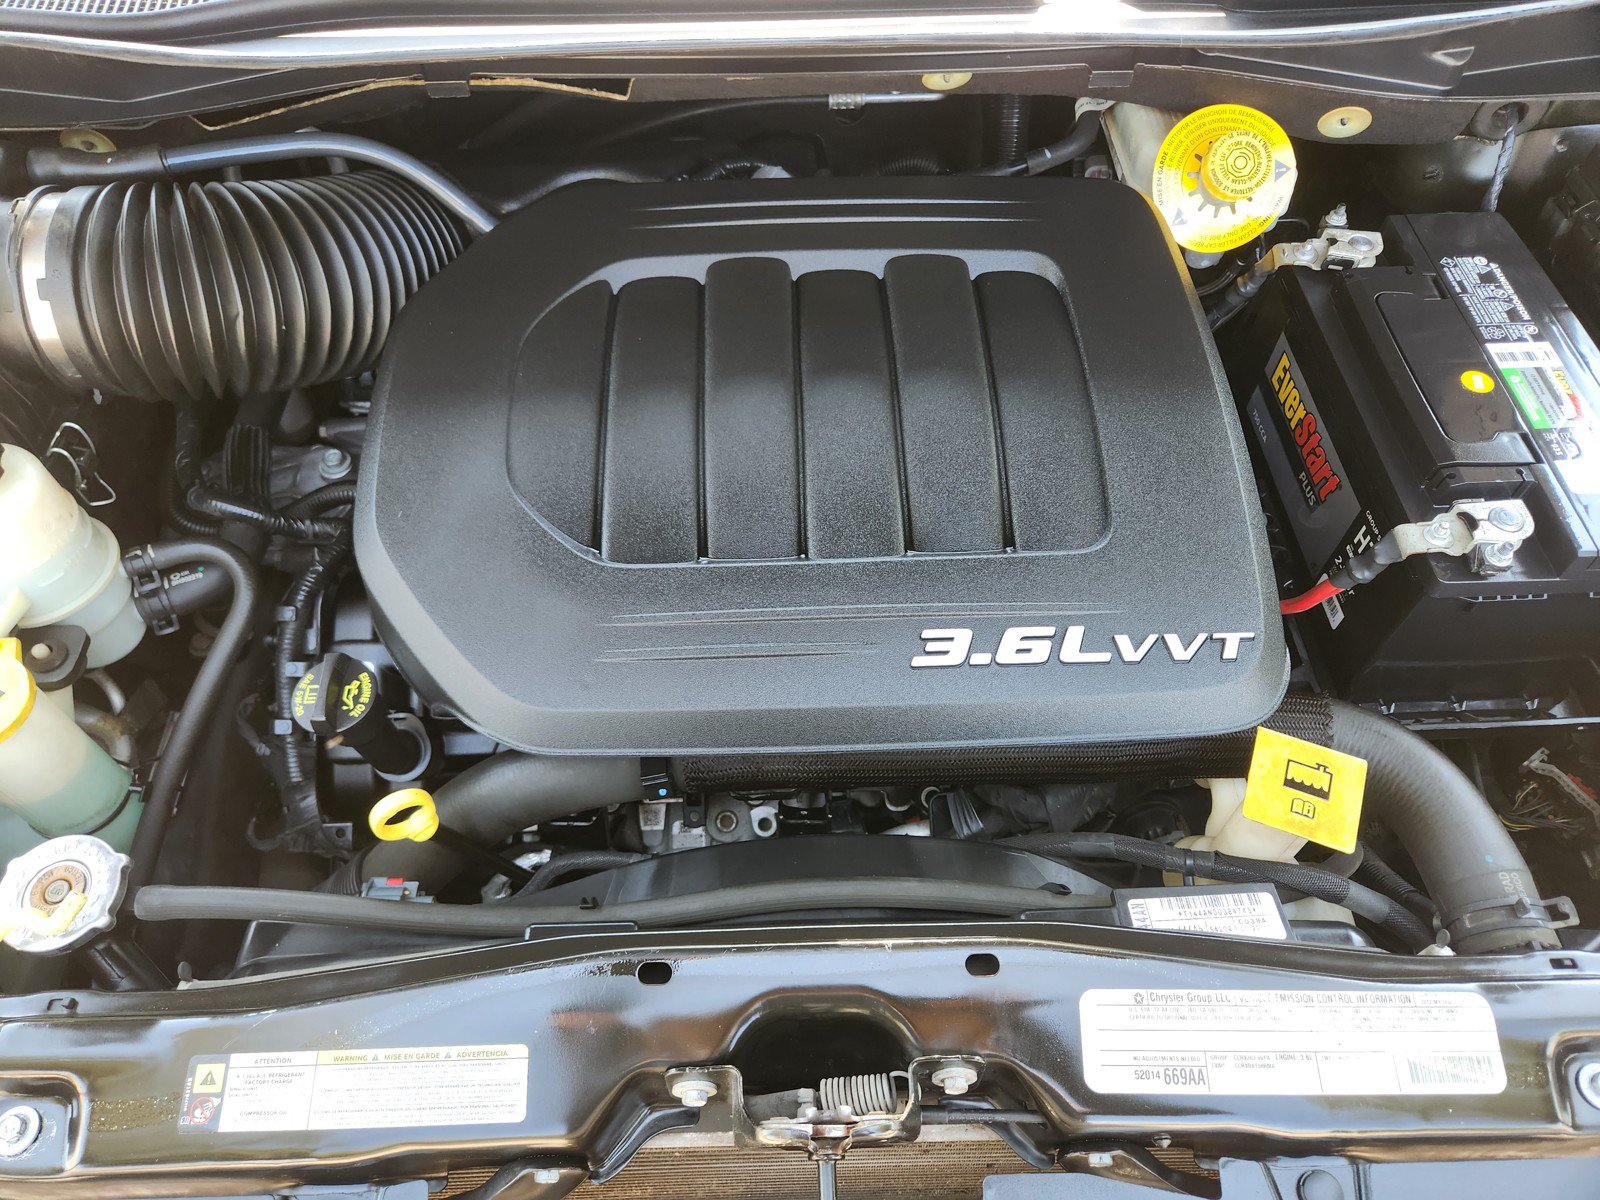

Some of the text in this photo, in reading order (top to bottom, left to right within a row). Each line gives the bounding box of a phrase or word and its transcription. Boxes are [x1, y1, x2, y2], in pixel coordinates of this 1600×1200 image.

[1157, 150, 1168, 174] GARDE
[1166, 121, 1189, 147] NETTOYER
[1196, 108, 1226, 120] BOUCHON
[1238, 109, 1275, 132] REMPLISSAGE
[1270, 351, 1342, 503] EverStart
[1298, 470, 1316, 507] PLUS
[1365, 510, 1379, 535] GROUP
[910, 625, 1255, 667] 3.6L VVT
[300, 673, 315, 690] SAE
[349, 671, 372, 718] ENGINE OIL
[1498, 872, 1513, 893] RAD
[1510, 872, 1528, 902] EXICO
[1150, 992, 1184, 1005] Chrysler
[1187, 992, 1212, 1005] Group
[1316, 994, 1352, 1004] CONTROL
[1356, 994, 1411, 1004] INFORMATION
[1135, 1068, 1206, 1085] 52014 669AA
